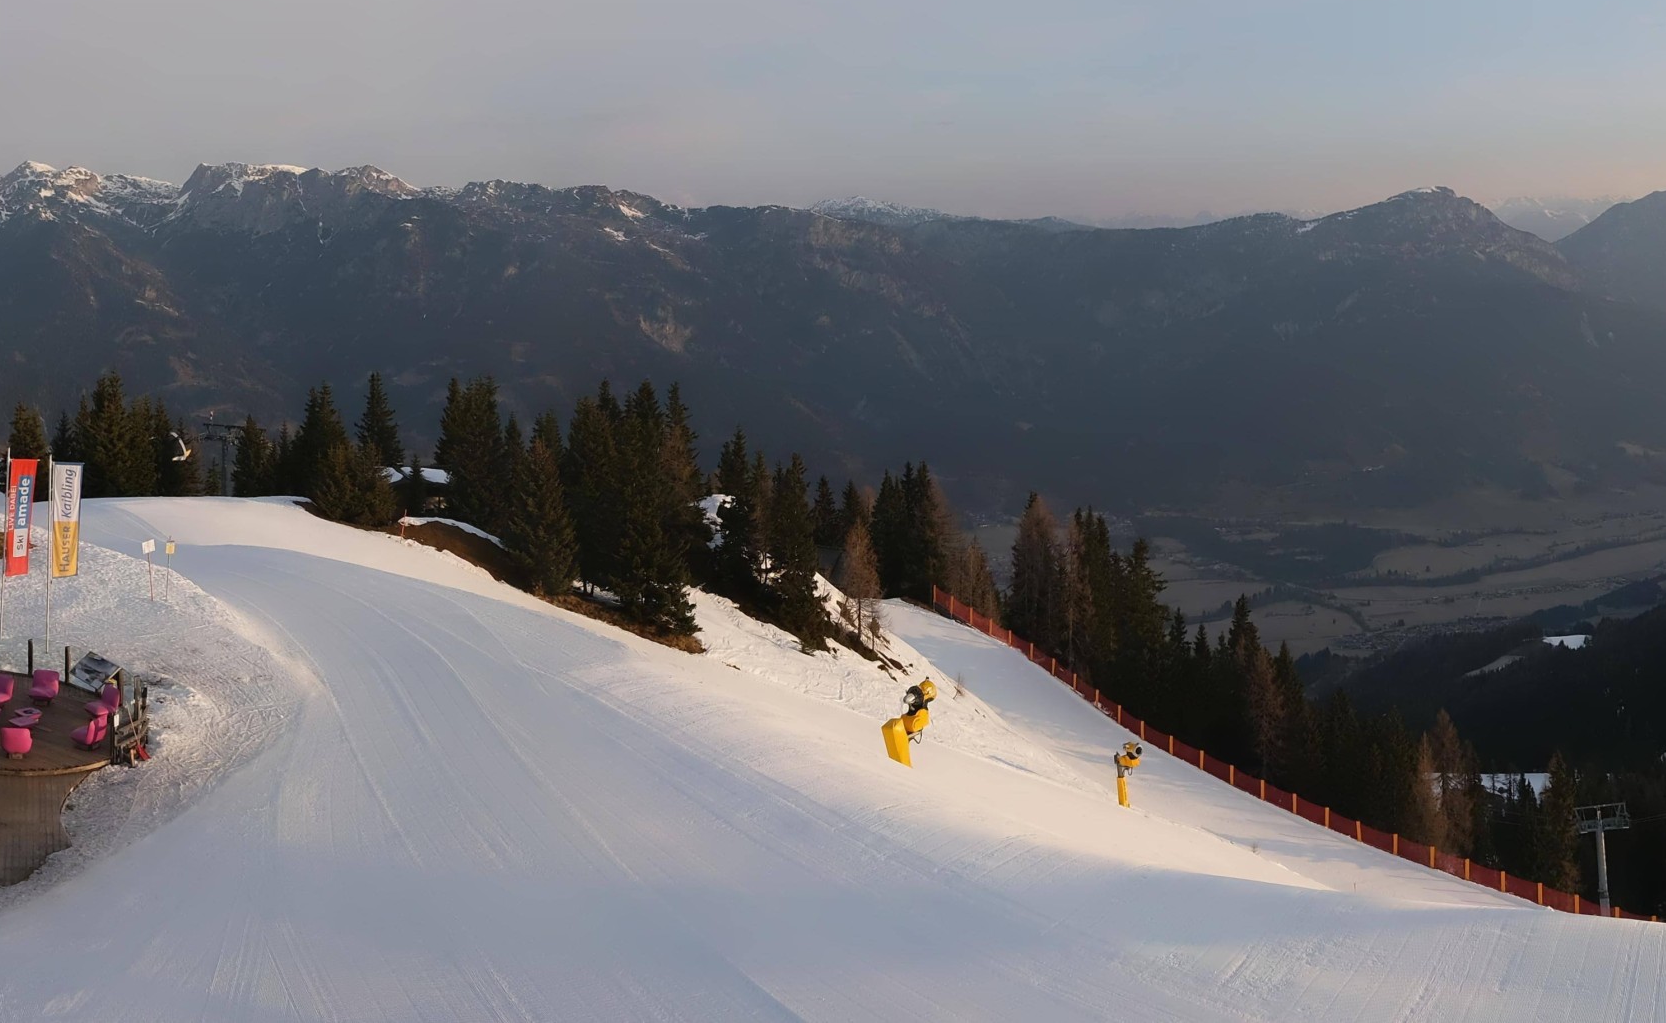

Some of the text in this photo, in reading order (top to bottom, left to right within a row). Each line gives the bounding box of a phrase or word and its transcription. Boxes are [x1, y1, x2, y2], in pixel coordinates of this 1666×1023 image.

[16, 535, 24, 551] Ski
[59, 468, 77, 572] HAUSER Kaibling
